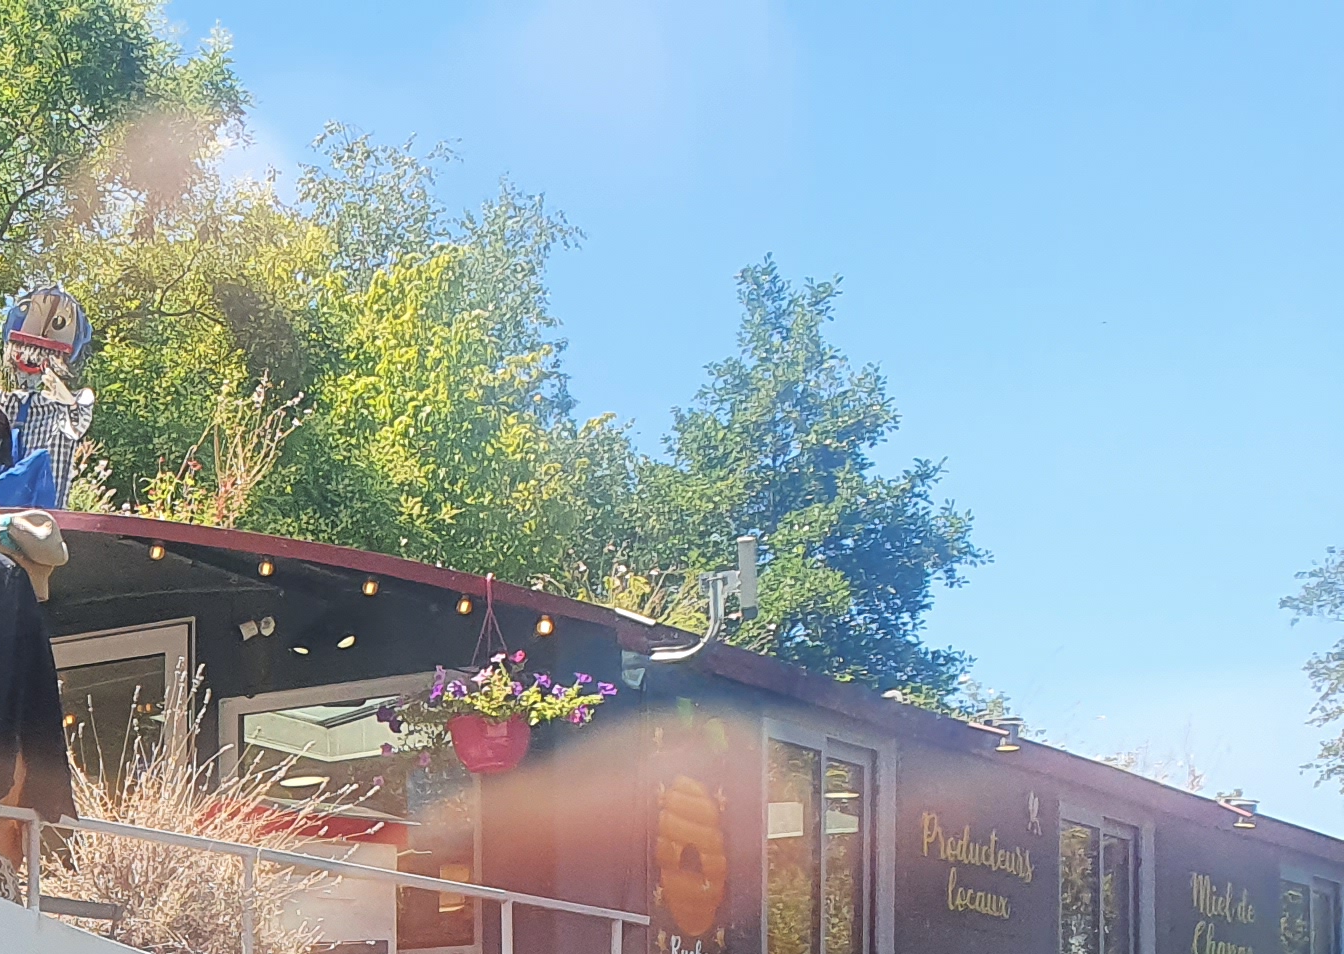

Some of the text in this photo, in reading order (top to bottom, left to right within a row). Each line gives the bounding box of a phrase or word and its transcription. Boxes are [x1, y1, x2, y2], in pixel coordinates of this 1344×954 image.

[921, 811, 1035, 883] Producteurs
[1190, 871, 1255, 923] Miel de
